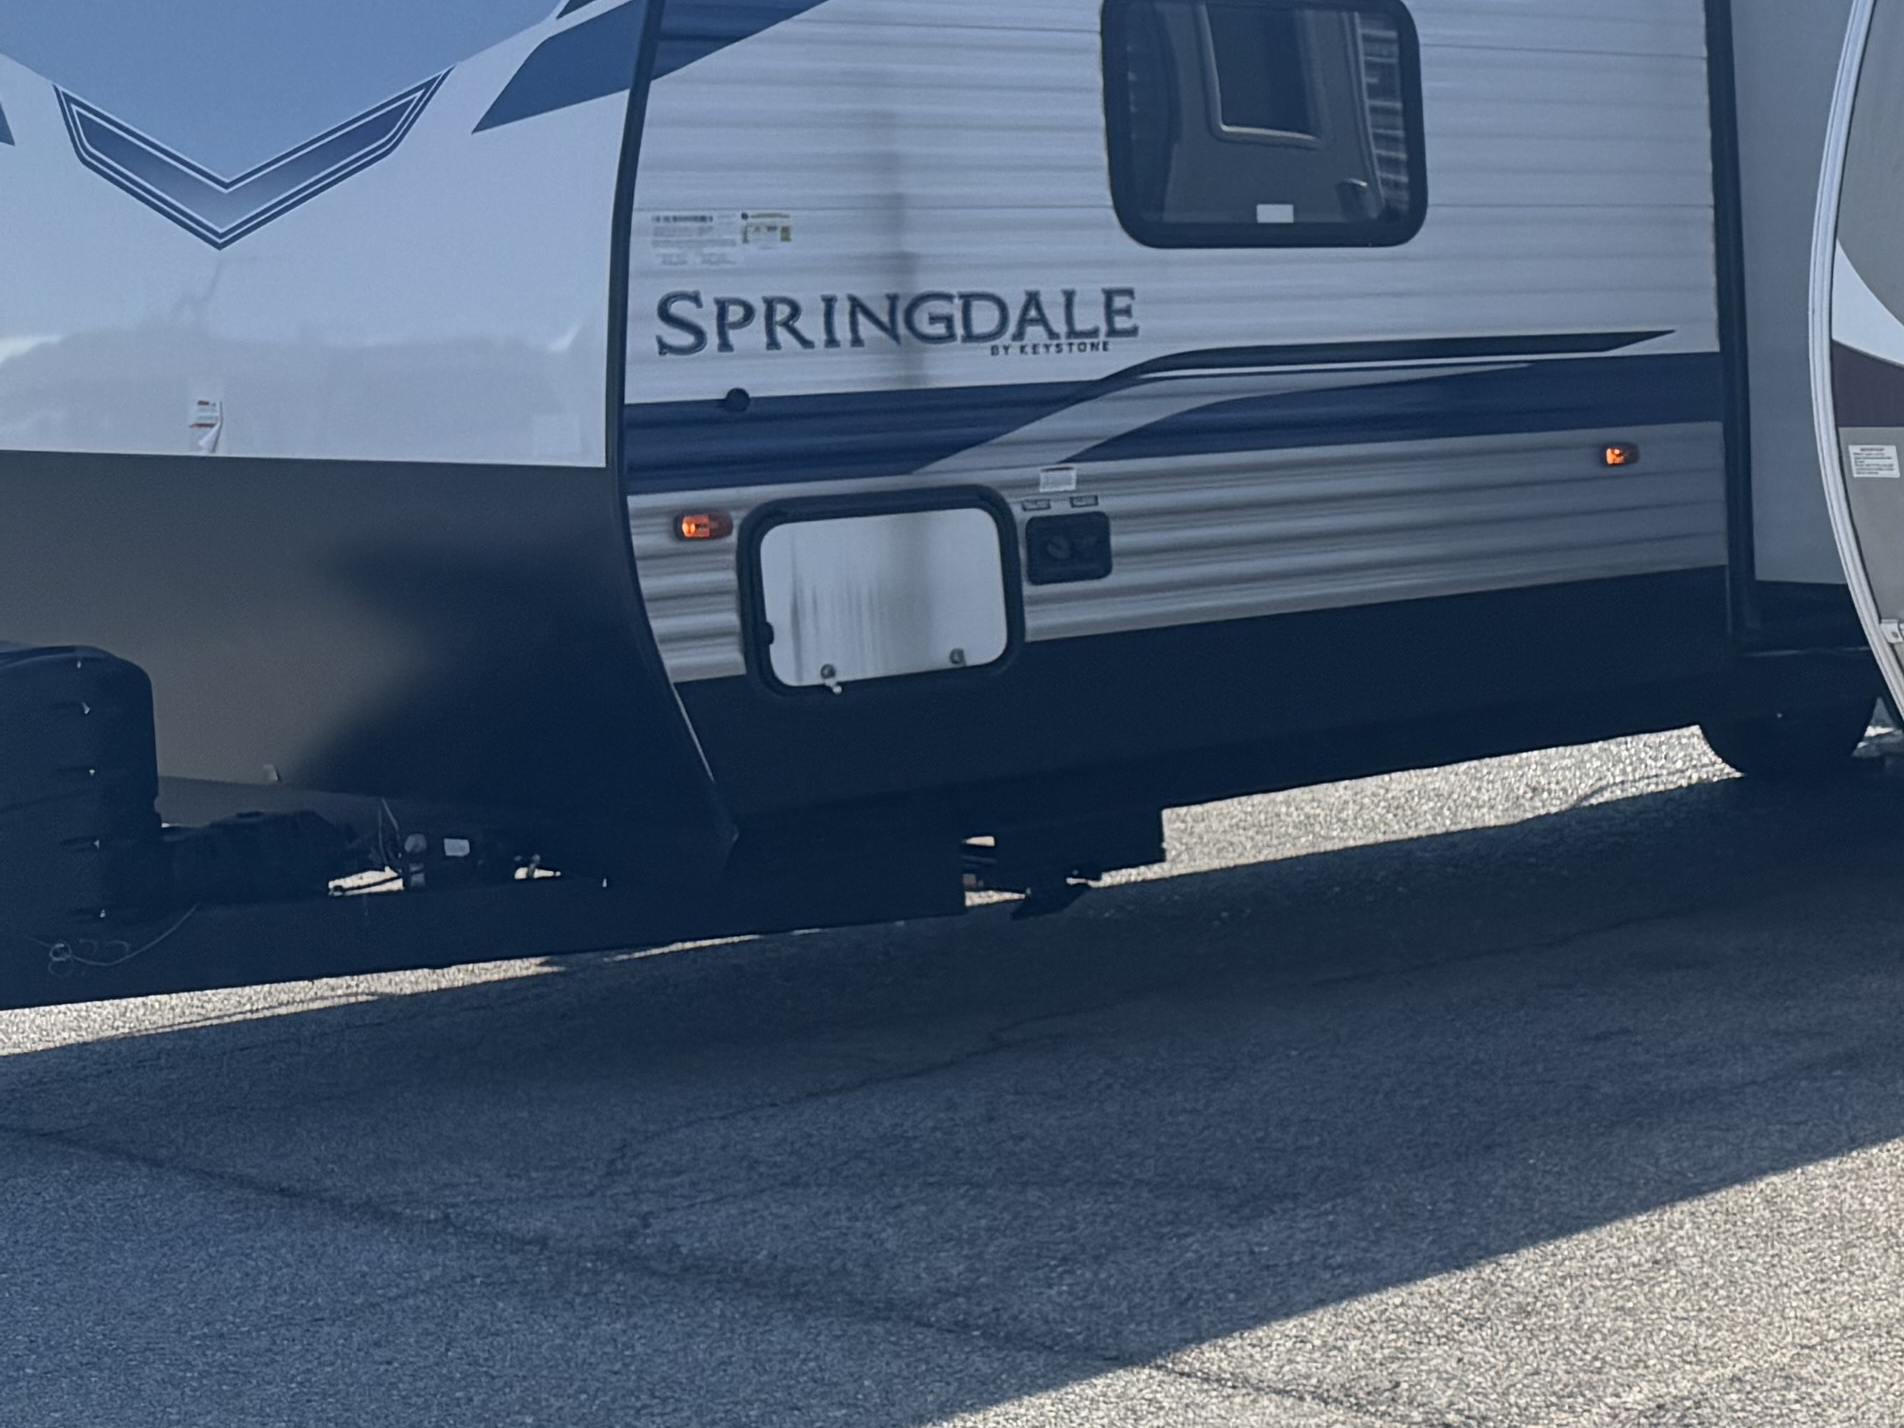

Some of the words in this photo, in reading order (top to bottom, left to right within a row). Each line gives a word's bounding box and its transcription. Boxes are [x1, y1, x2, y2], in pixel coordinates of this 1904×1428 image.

[655, 287, 1140, 357] SPRINGDALE
[990, 345, 1012, 356] BY
[1019, 340, 1110, 355] KEYSTONE
